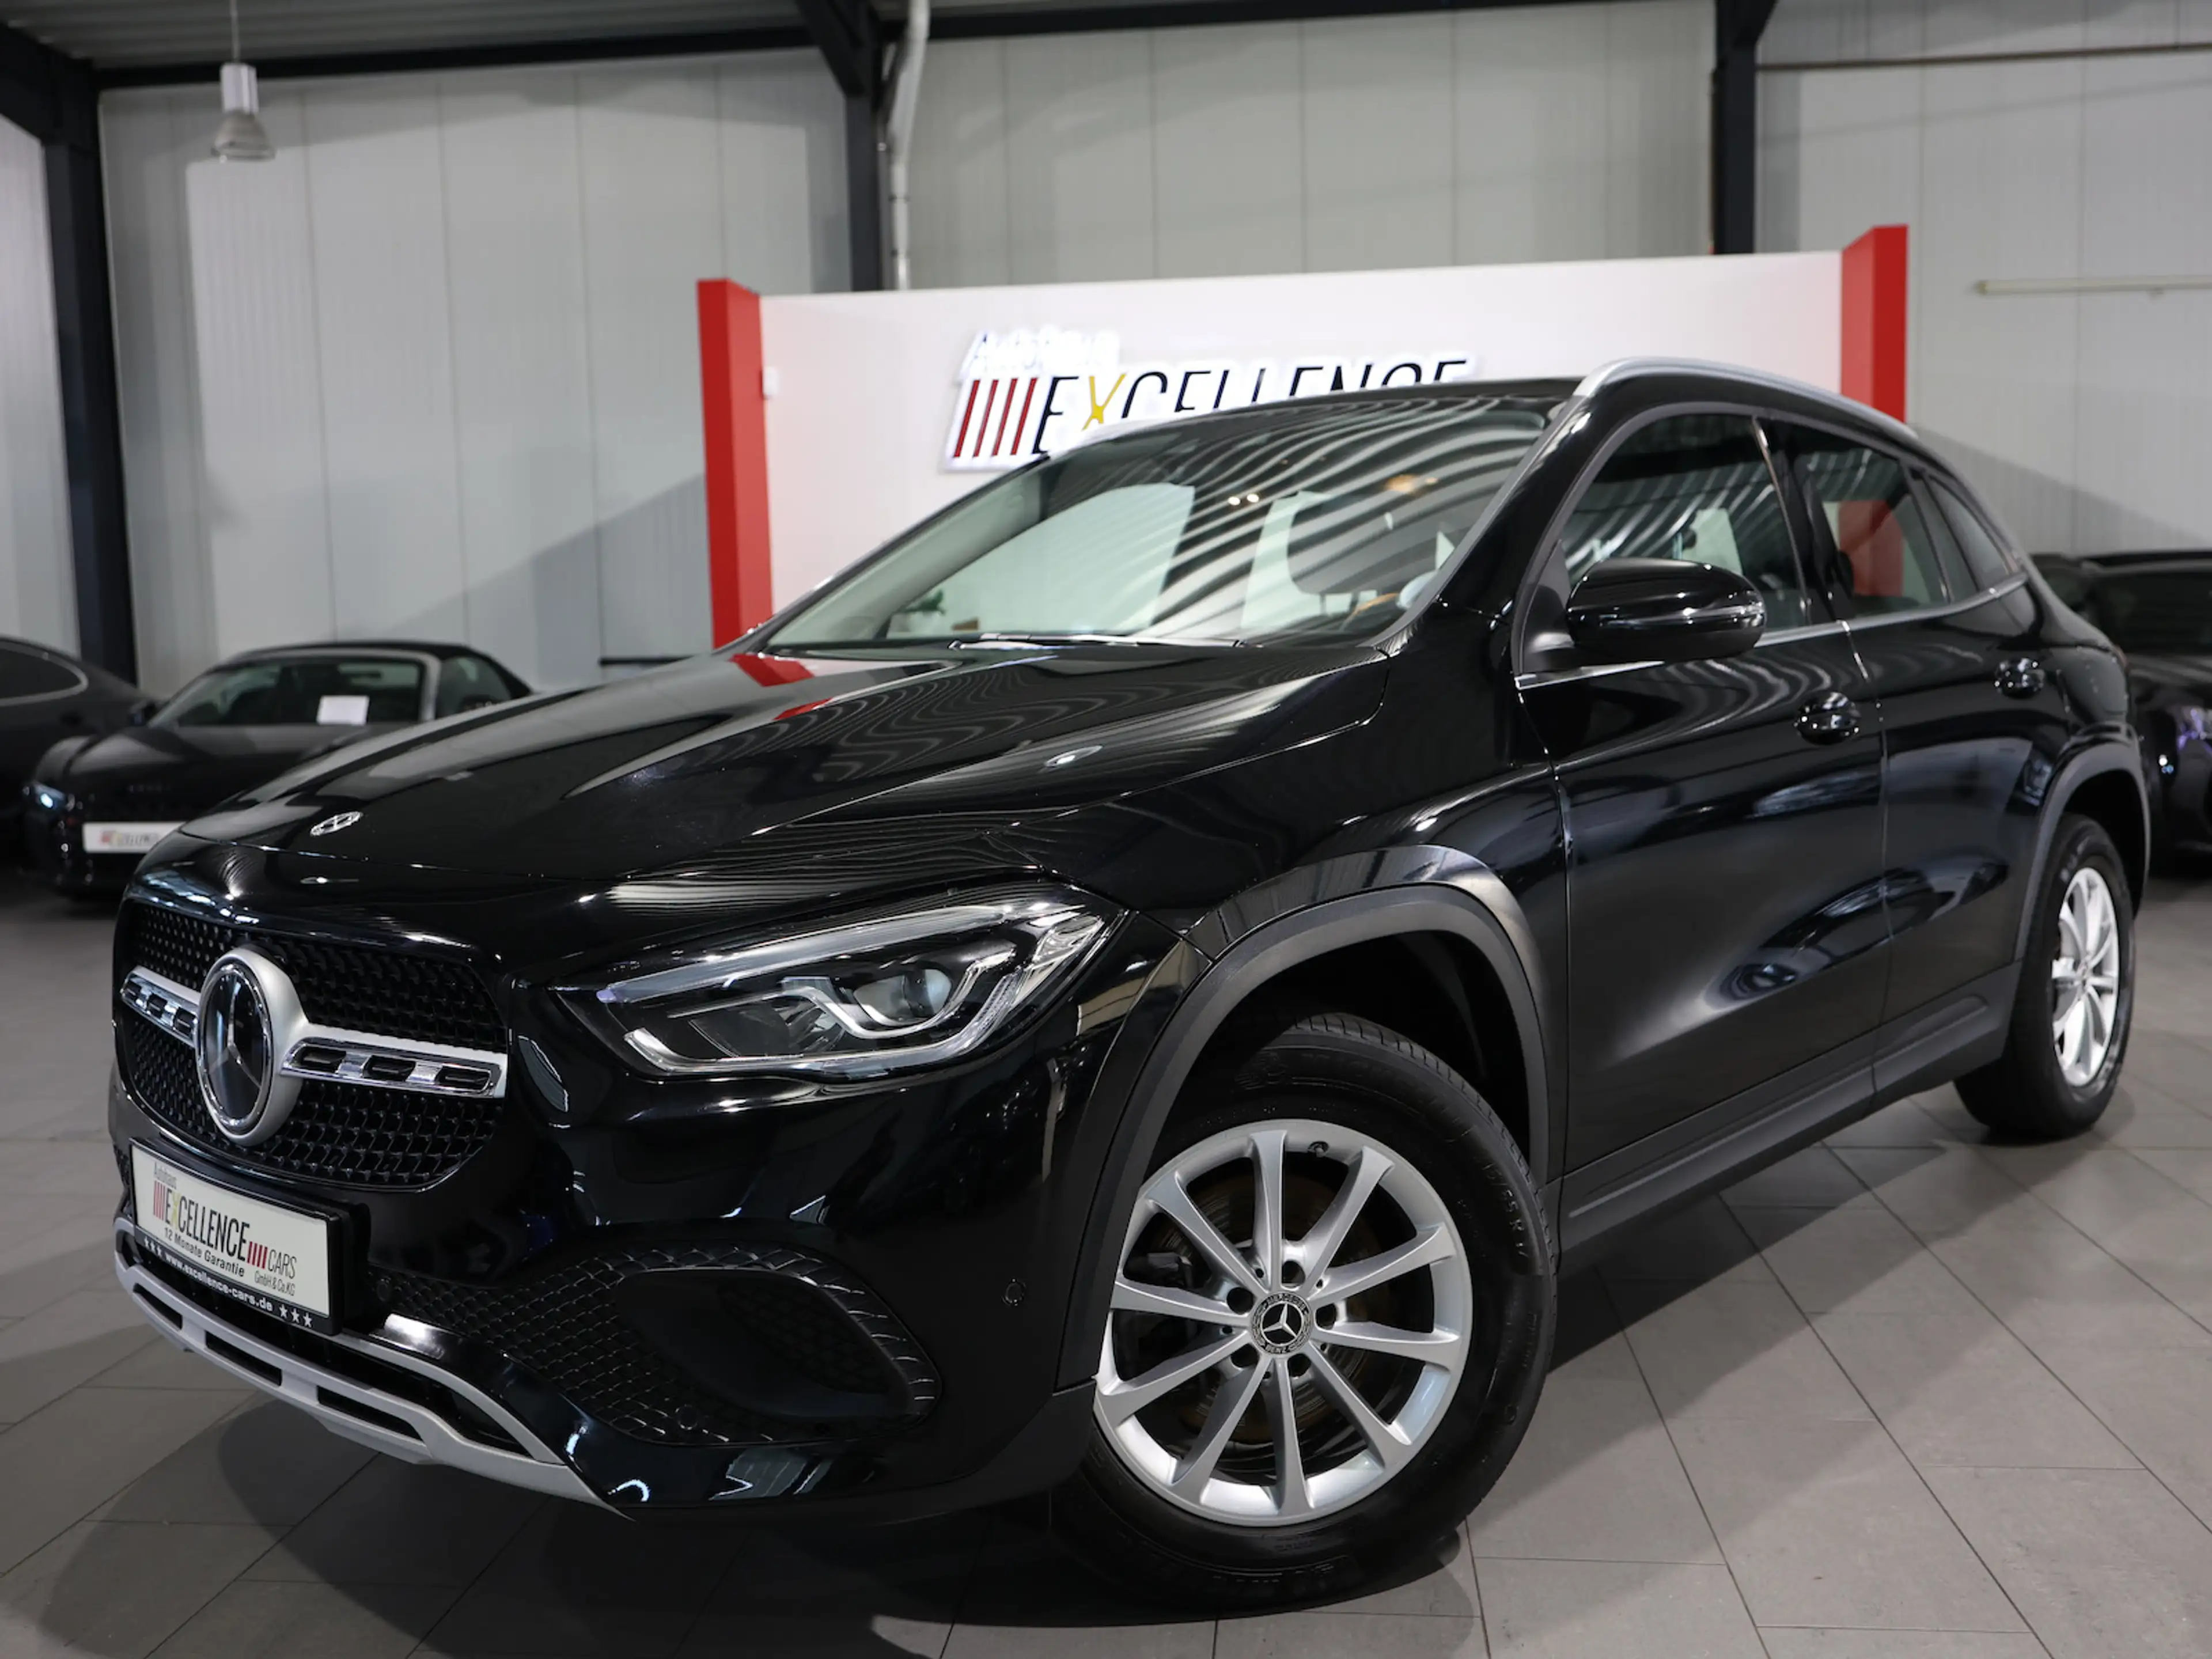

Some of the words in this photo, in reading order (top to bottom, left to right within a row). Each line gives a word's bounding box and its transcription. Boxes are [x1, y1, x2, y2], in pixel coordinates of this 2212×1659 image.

[1032, 359, 1468, 454] EXCEL
[165, 1187, 250, 1262] EXCELLENCE
[268, 1248, 297, 1279] CARS
[165, 1226, 173, 1241] 12
[174, 1232, 202, 1258] Monate
[204, 1249, 245, 1277] Garantie
[165, 1252, 274, 1312] www.excellence-cars.de
